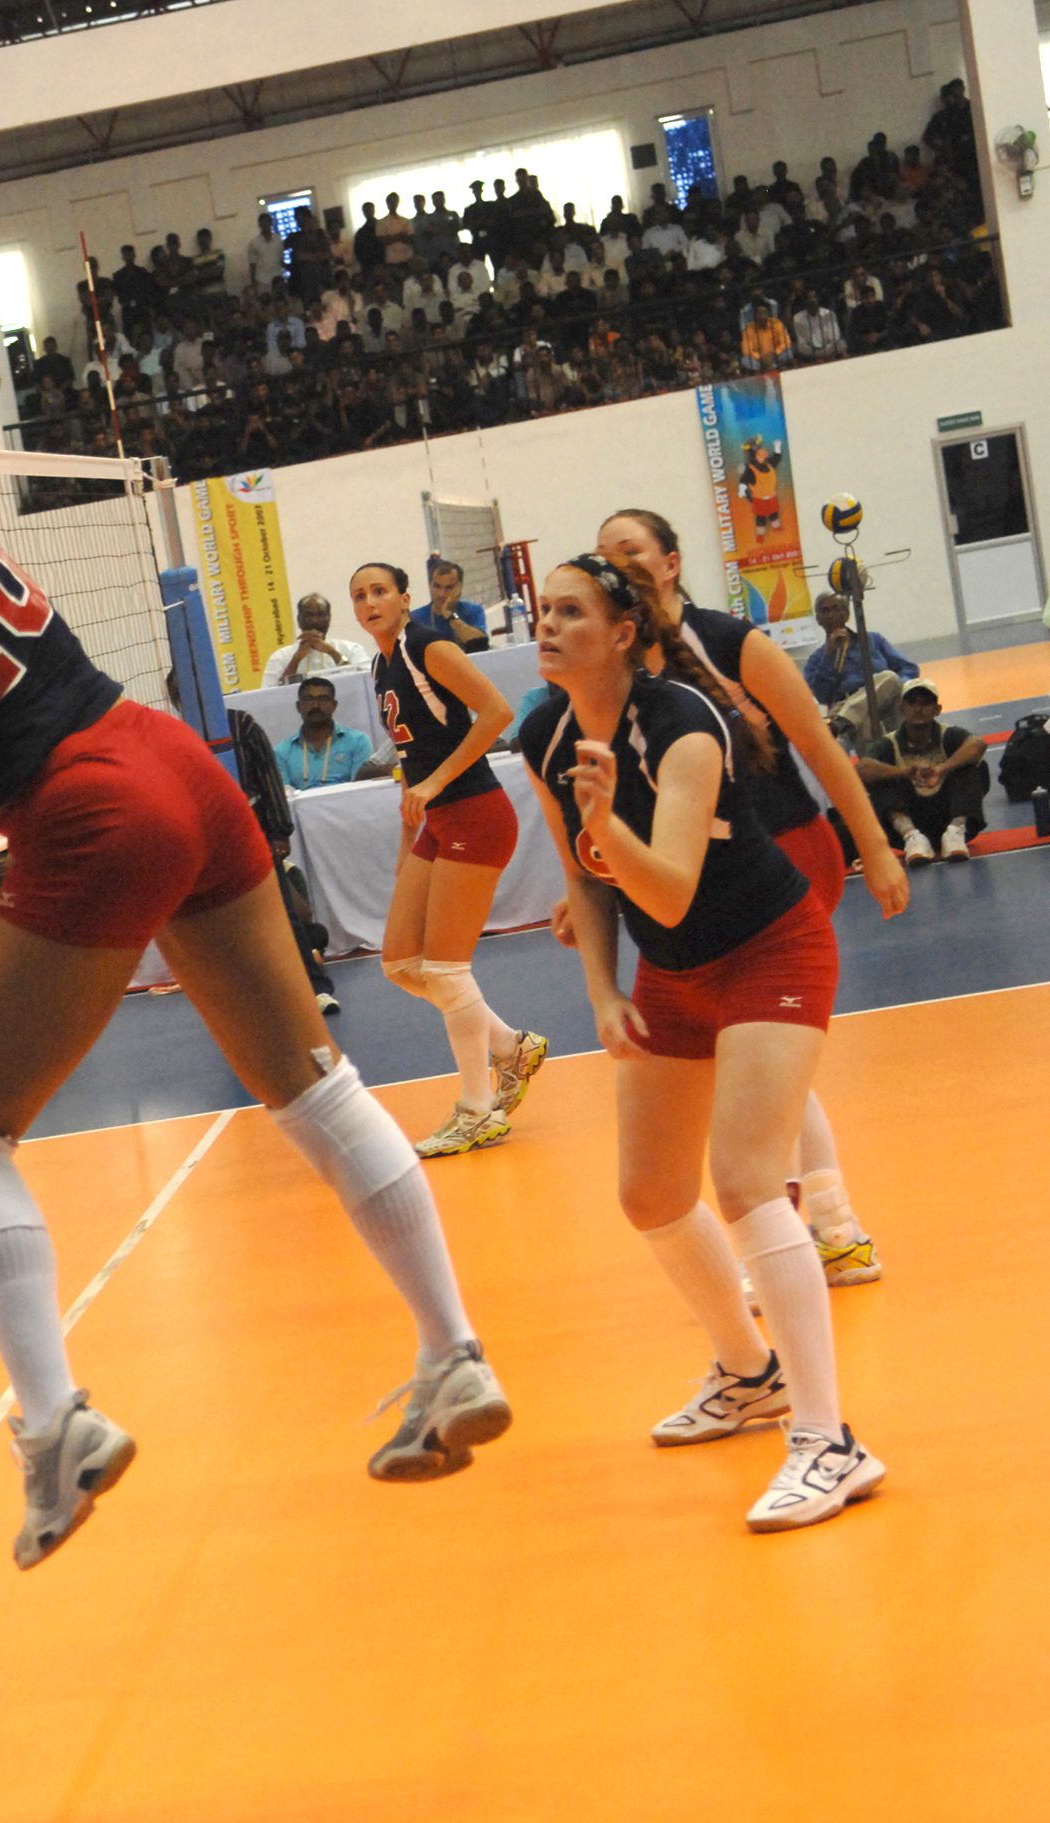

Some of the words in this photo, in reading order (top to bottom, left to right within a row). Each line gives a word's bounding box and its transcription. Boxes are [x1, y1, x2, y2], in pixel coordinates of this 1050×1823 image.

[706, 428, 726, 482] WORLD
[973, 443, 985, 456] C
[226, 504, 239, 540] SPORT
[714, 486, 736, 551] MILITARY
[201, 524, 221, 577] WORLD
[260, 528, 271, 562] October
[233, 542, 249, 600] THROUGH
[725, 561, 743, 594] CISM
[210, 580, 232, 643] MILITARY
[270, 598, 285, 645] Hyderabad
[242, 604, 260, 672] FRIENDSHIP
[222, 652, 239, 684] CISM
